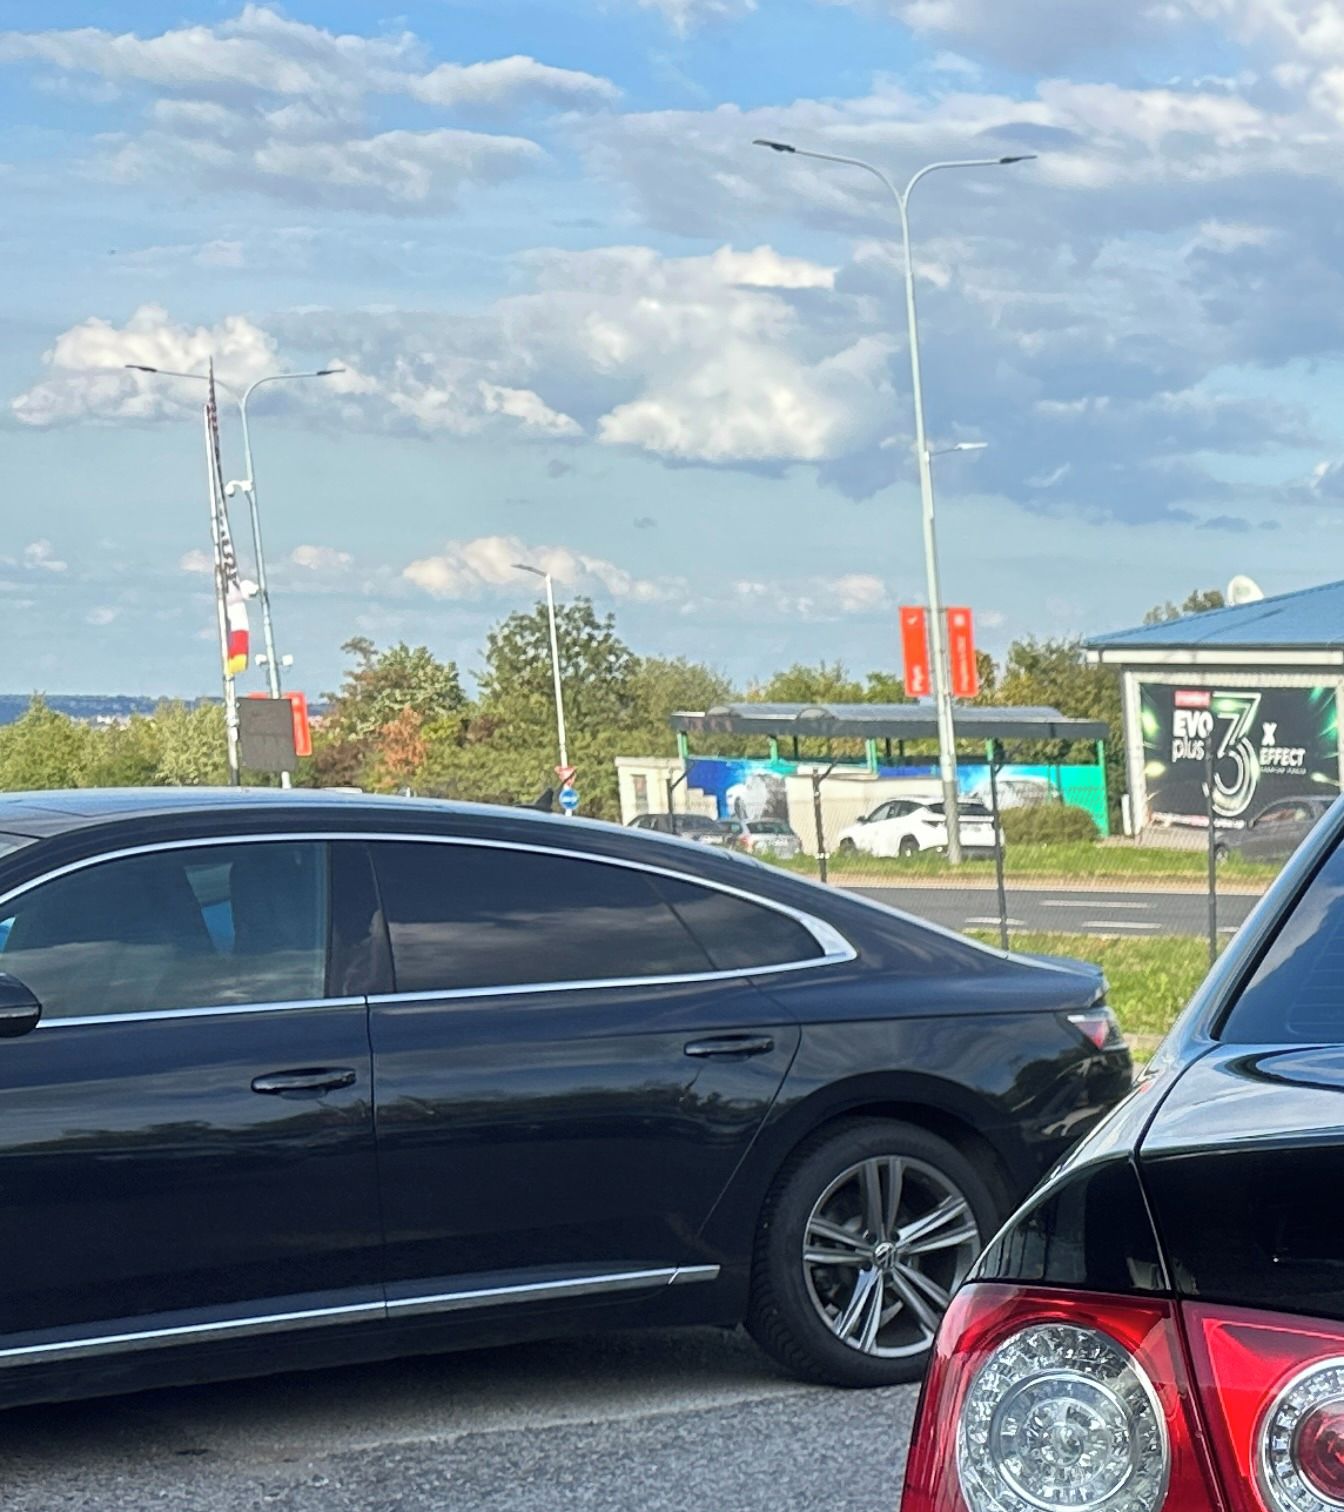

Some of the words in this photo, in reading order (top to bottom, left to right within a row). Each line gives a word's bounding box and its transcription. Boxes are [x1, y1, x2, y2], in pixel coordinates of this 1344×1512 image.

[1173, 710, 1213, 738] EVO
[1172, 736, 1205, 762] plus
[1259, 748, 1306, 766] EFFECT
